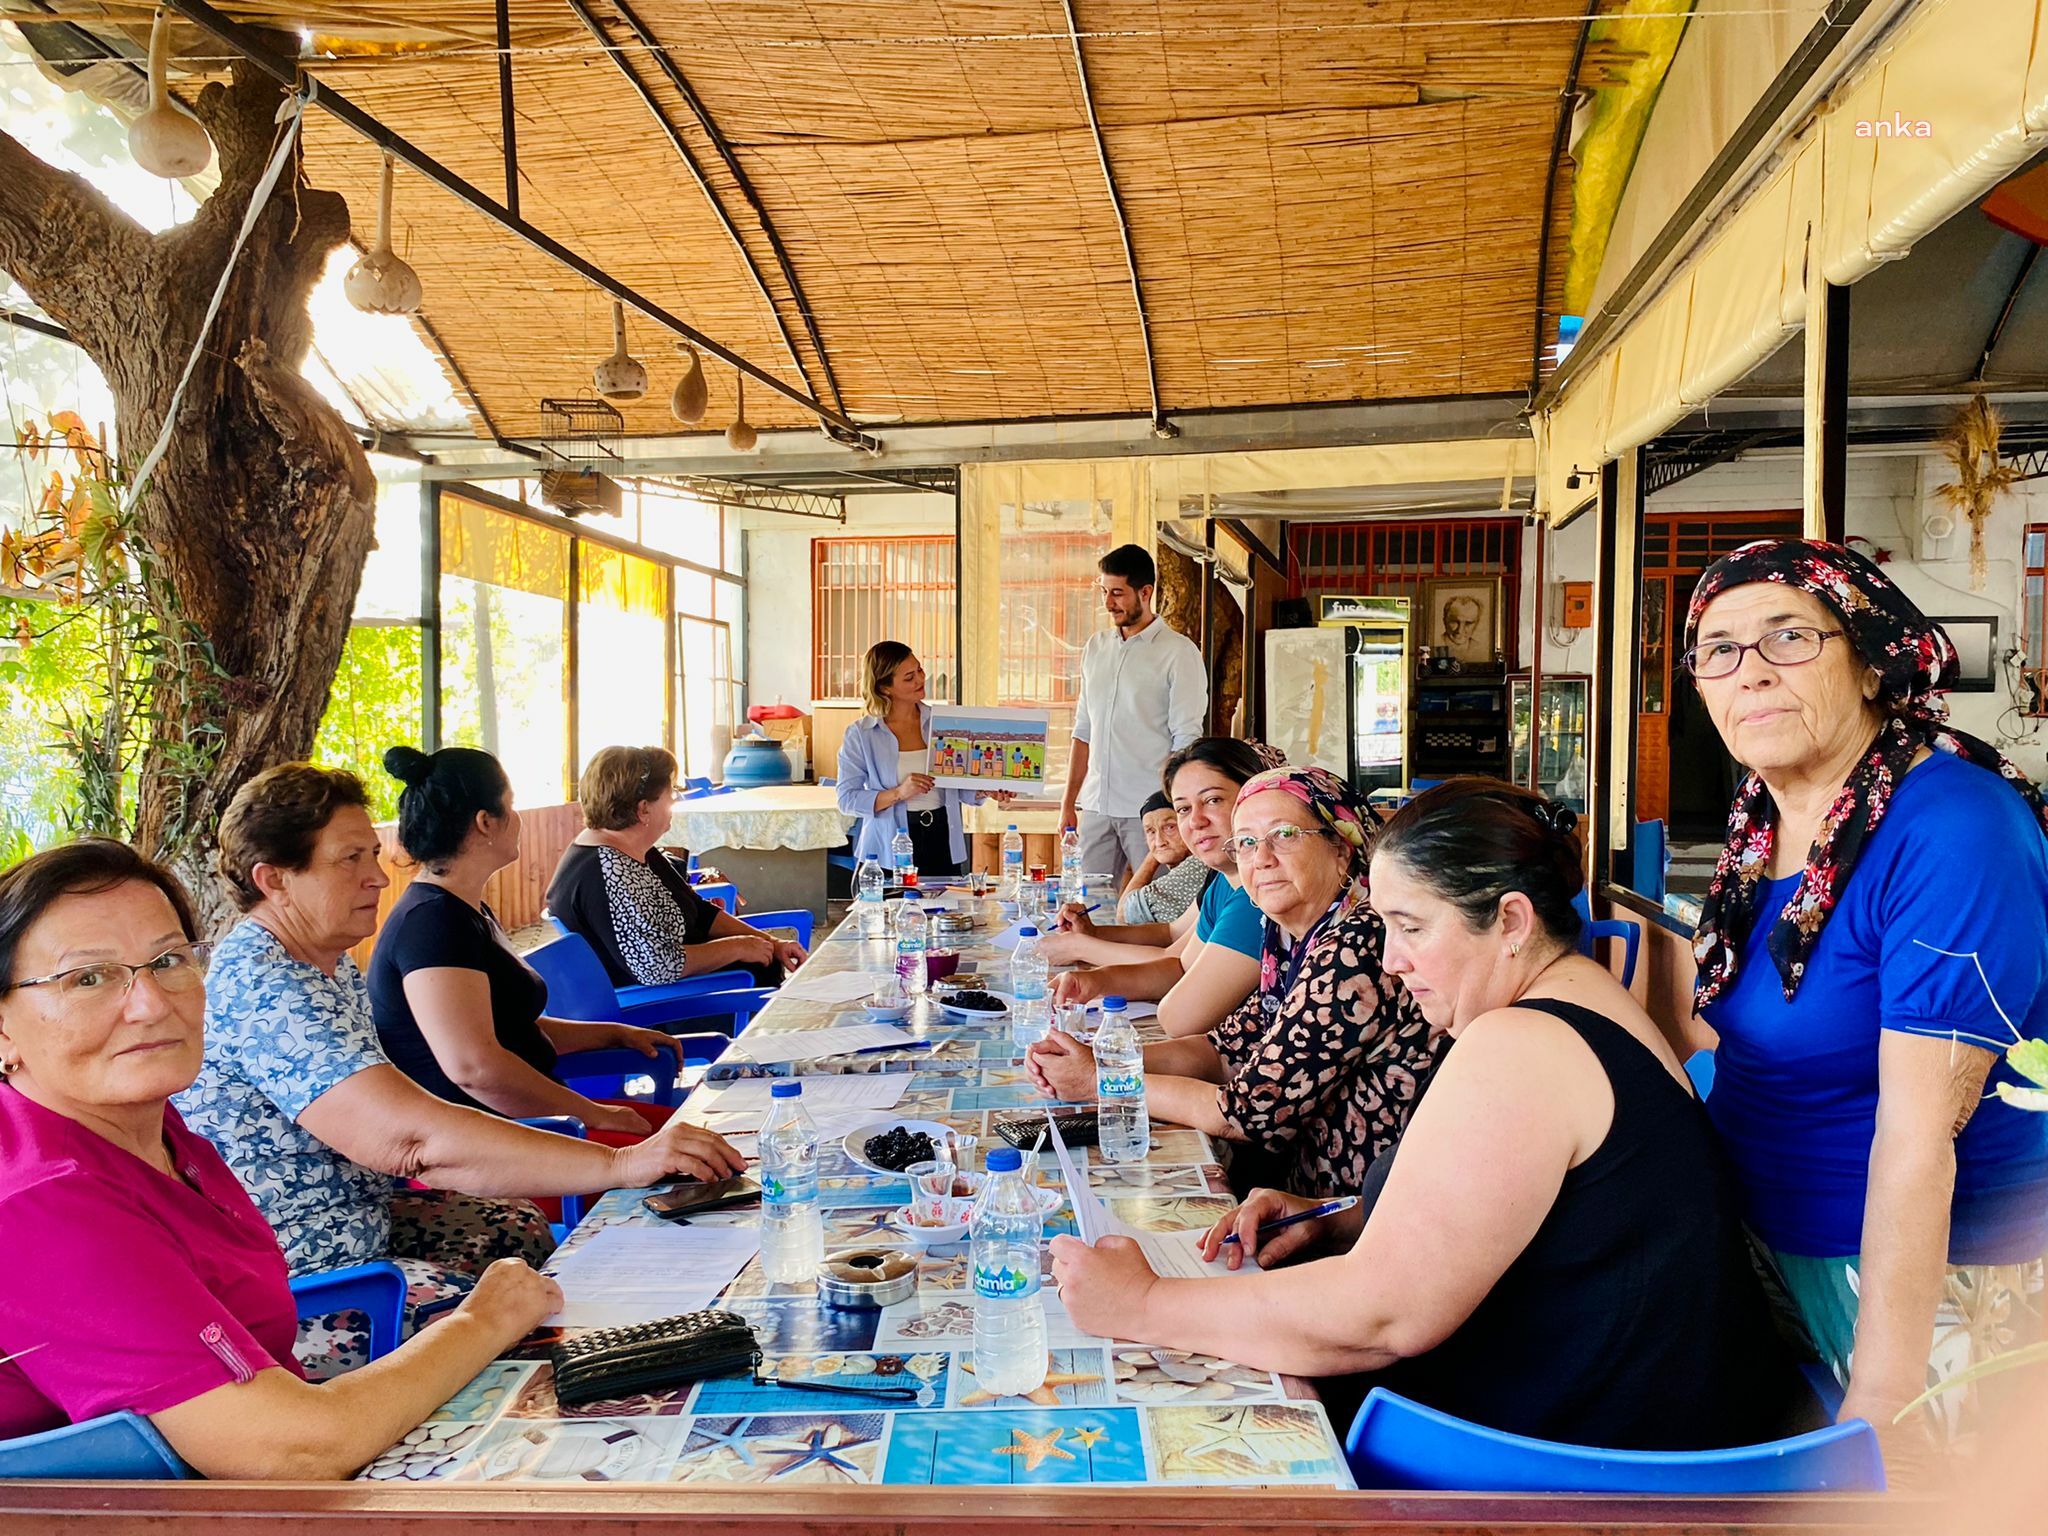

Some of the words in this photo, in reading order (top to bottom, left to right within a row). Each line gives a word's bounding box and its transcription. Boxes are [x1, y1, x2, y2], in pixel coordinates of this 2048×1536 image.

[1332, 601, 1365, 614] fuse
[1103, 1082, 1136, 1092] damla
[975, 1272, 1015, 1291] damla
